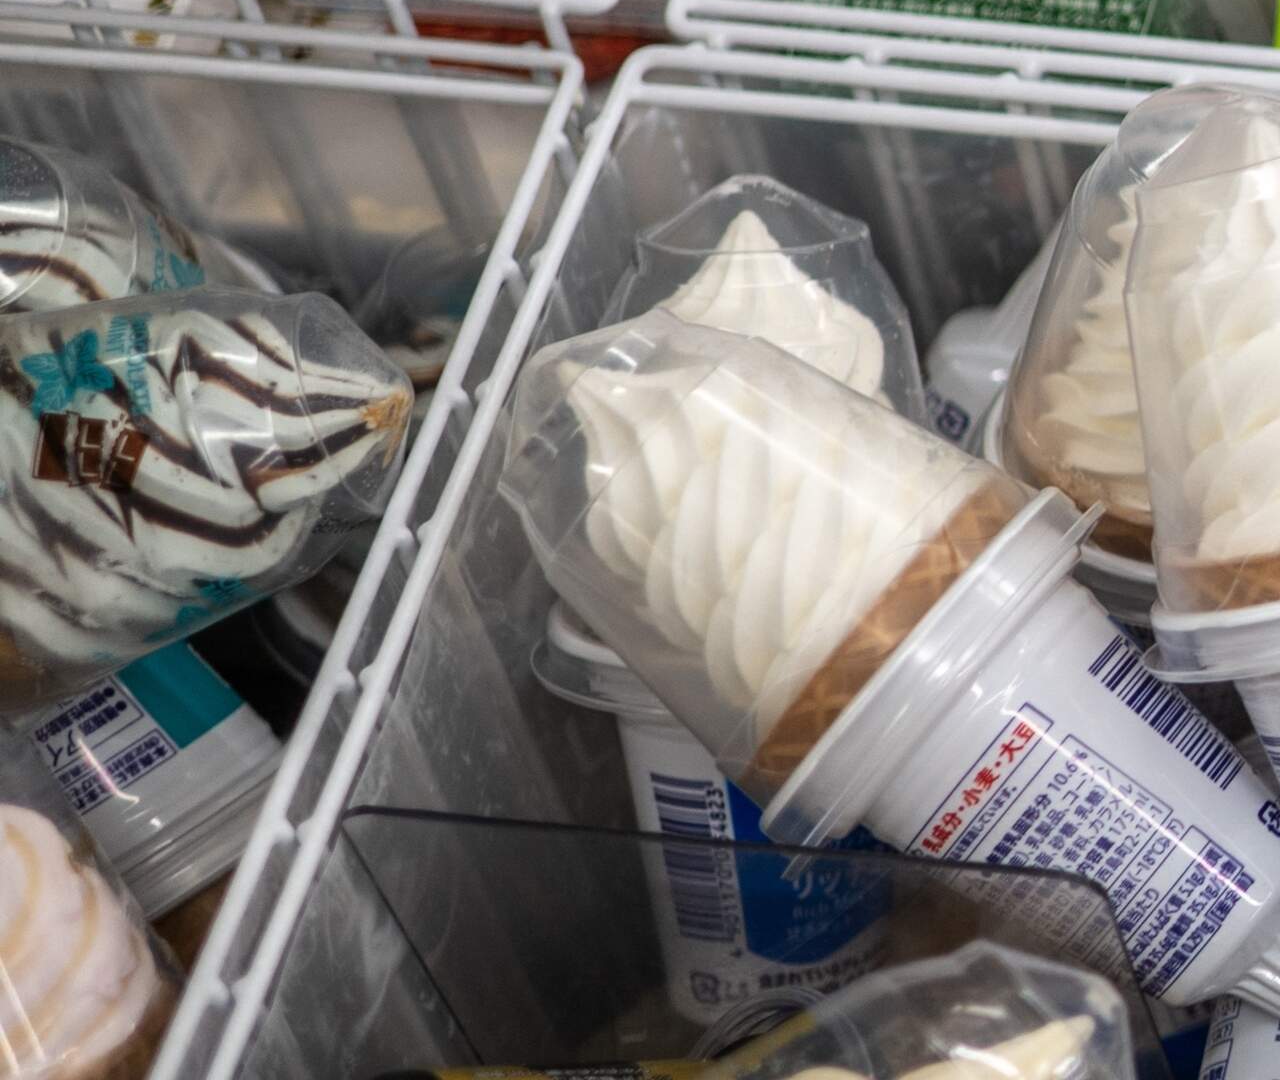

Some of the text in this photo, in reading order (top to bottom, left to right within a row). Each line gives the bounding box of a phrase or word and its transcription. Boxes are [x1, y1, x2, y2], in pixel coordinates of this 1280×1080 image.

[922, 719, 1038, 856] 乳成分・小麦・大豆
